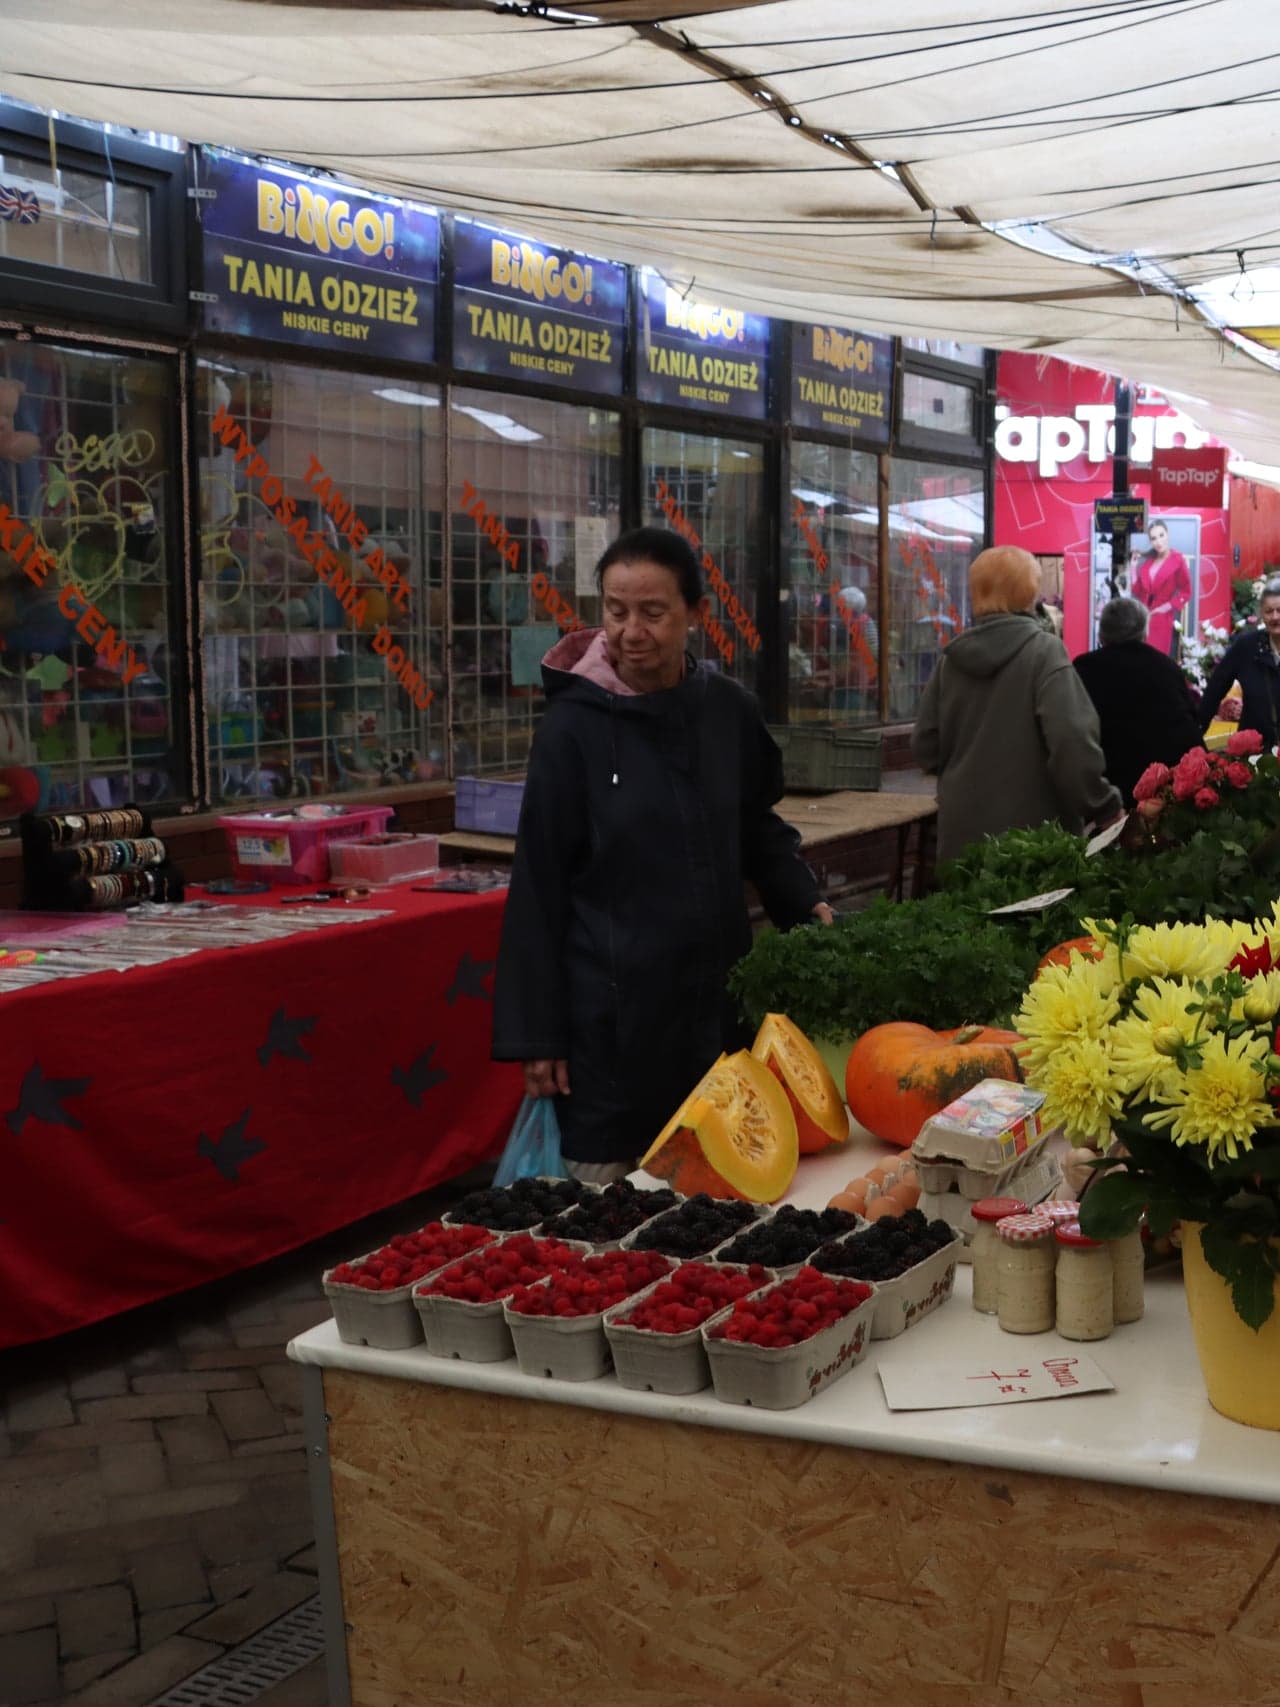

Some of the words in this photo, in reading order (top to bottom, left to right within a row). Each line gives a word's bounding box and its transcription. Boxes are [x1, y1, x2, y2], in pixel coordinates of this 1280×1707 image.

[223, 254, 315, 307] TANIA
[321, 276, 418, 326] ODZIEŻ
[283, 312, 330, 334] NISKIE
[333, 321, 370, 341] CENY
[467, 304, 535, 348] TANIA
[539, 321, 612, 363] ODZIEŻ
[510, 351, 545, 370] NISKIE
[547, 358, 575, 376] CENY
[649, 345, 699, 380] TANIA
[701, 357, 759, 391] ODZIEŻ
[798, 377, 837, 407] TANIA
[840, 387, 884, 417] ODZIEŻ
[995, 404, 1210, 478] apTap
[303, 455, 369, 550] TANIE
[1158, 467, 1214, 488] TapTap
[459, 479, 522, 572] TANIA
[57, 583, 148, 685] CENY
[702, 552, 763, 654] PROSZKI
[371, 625, 435, 711] DOMU
